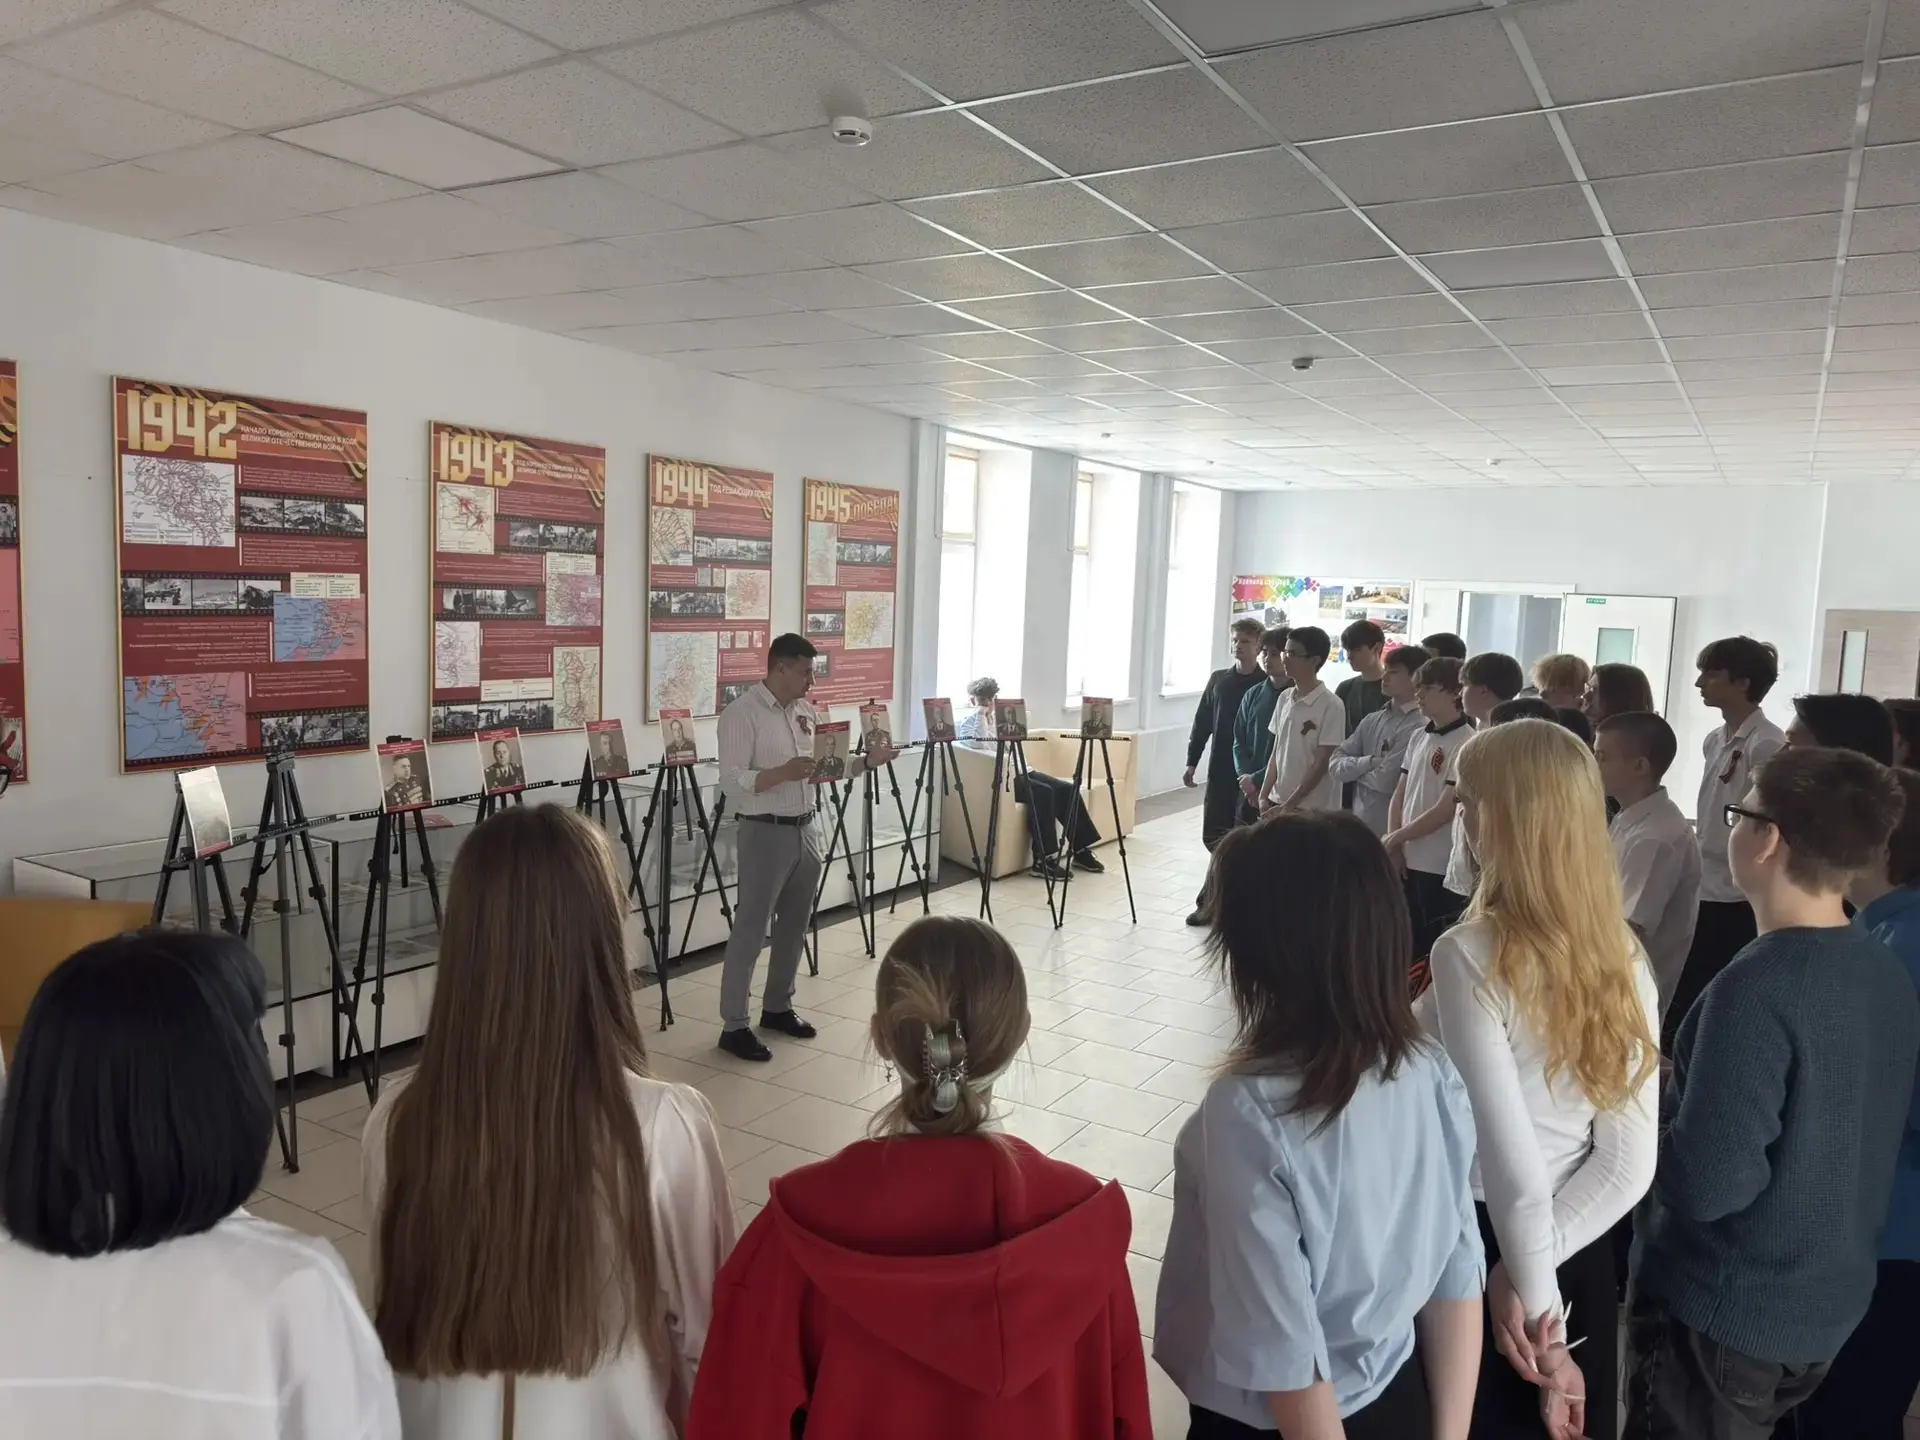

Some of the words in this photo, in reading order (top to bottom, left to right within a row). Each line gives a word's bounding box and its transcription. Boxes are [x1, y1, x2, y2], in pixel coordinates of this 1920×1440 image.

[127, 389, 237, 459] 1942
[241, 426, 267, 435] НАЧАЛО
[241, 434, 271, 443] ВЕЛИКОЙ
[440, 431, 515, 487] 1943
[655, 461, 709, 507] 1944
[710, 484, 722, 494] ГОД
[810, 484, 851, 523] 1945
